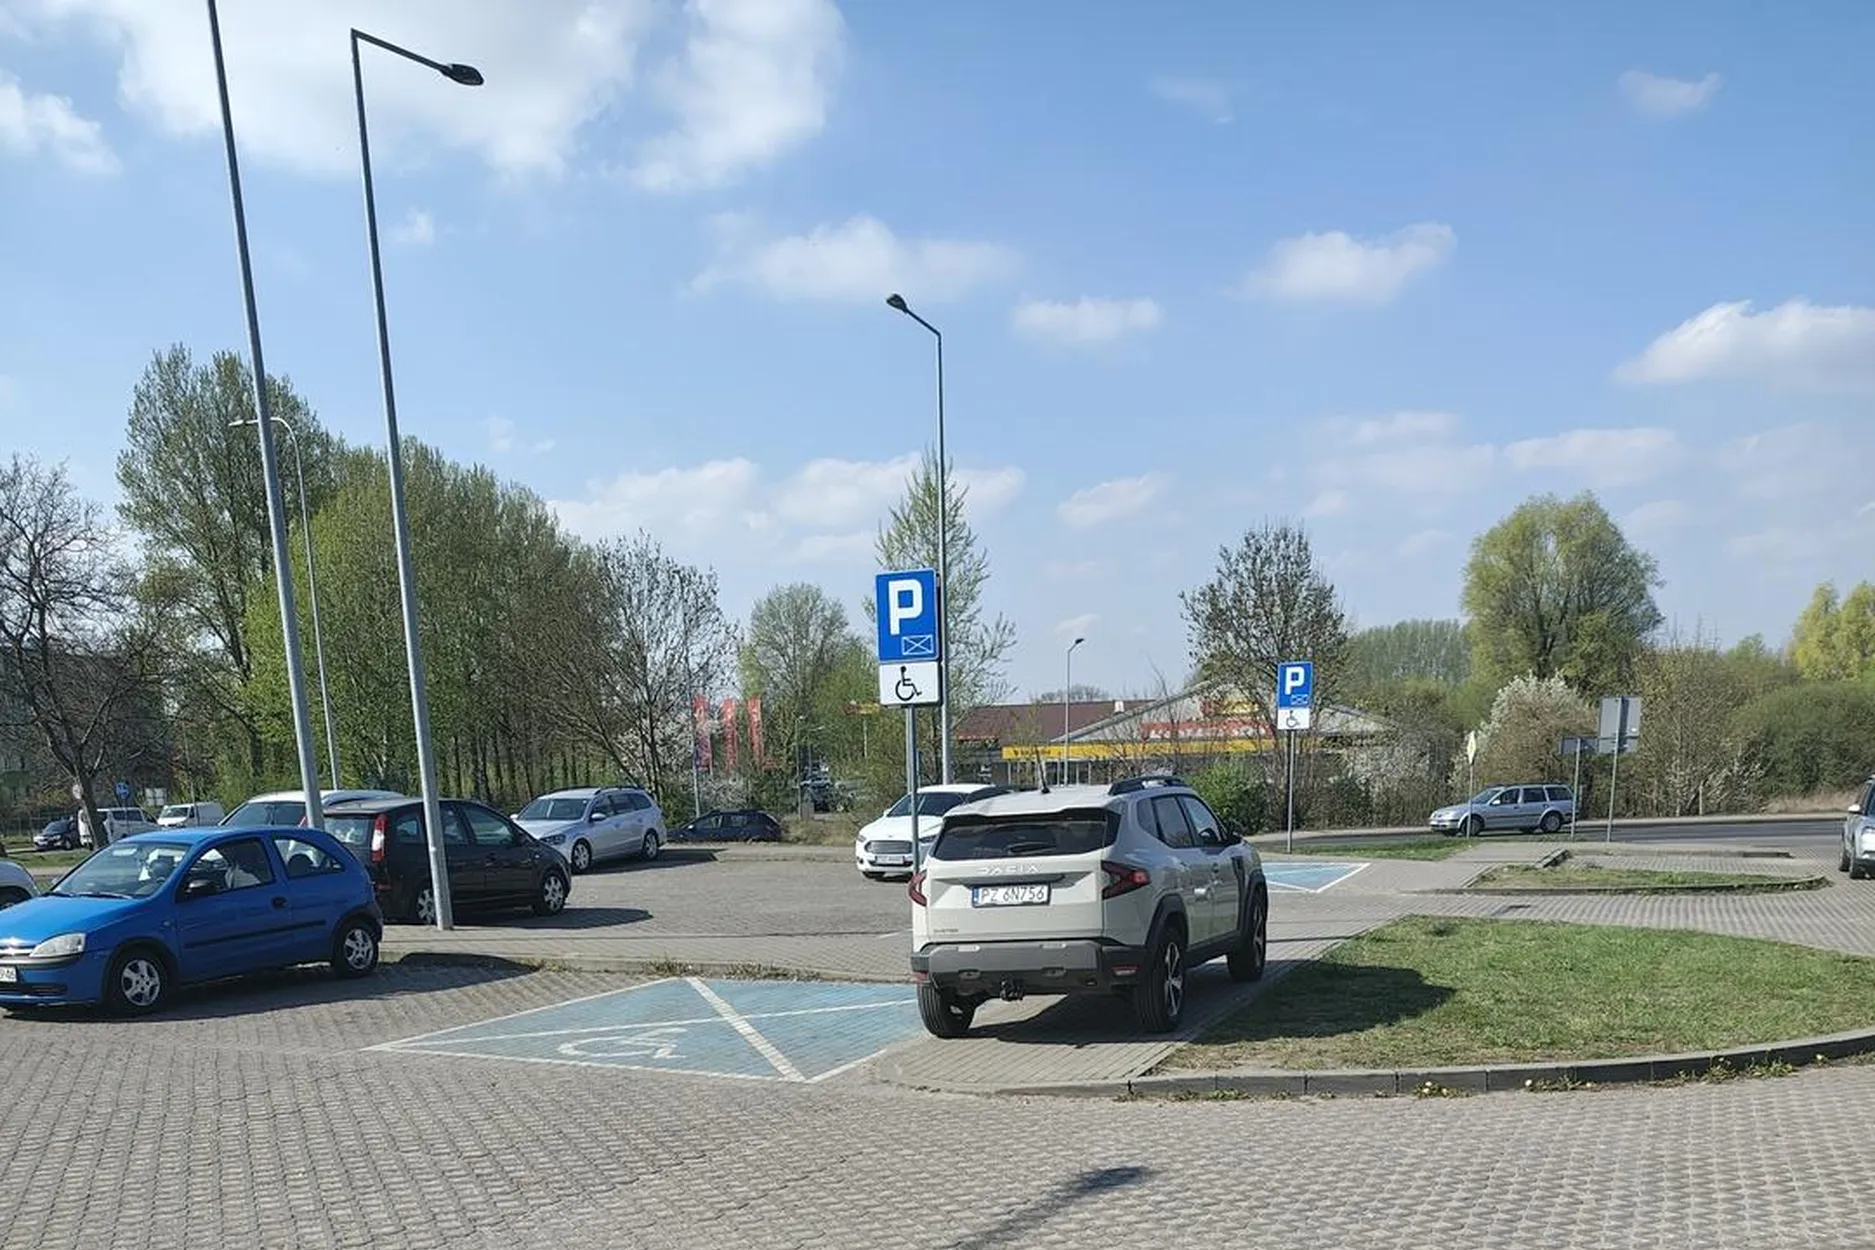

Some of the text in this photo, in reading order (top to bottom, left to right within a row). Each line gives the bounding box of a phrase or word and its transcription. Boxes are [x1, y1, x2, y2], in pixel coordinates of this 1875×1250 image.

[888, 579, 922, 635] P
[1285, 666, 1304, 695] P
[981, 887, 999, 901] PZ
